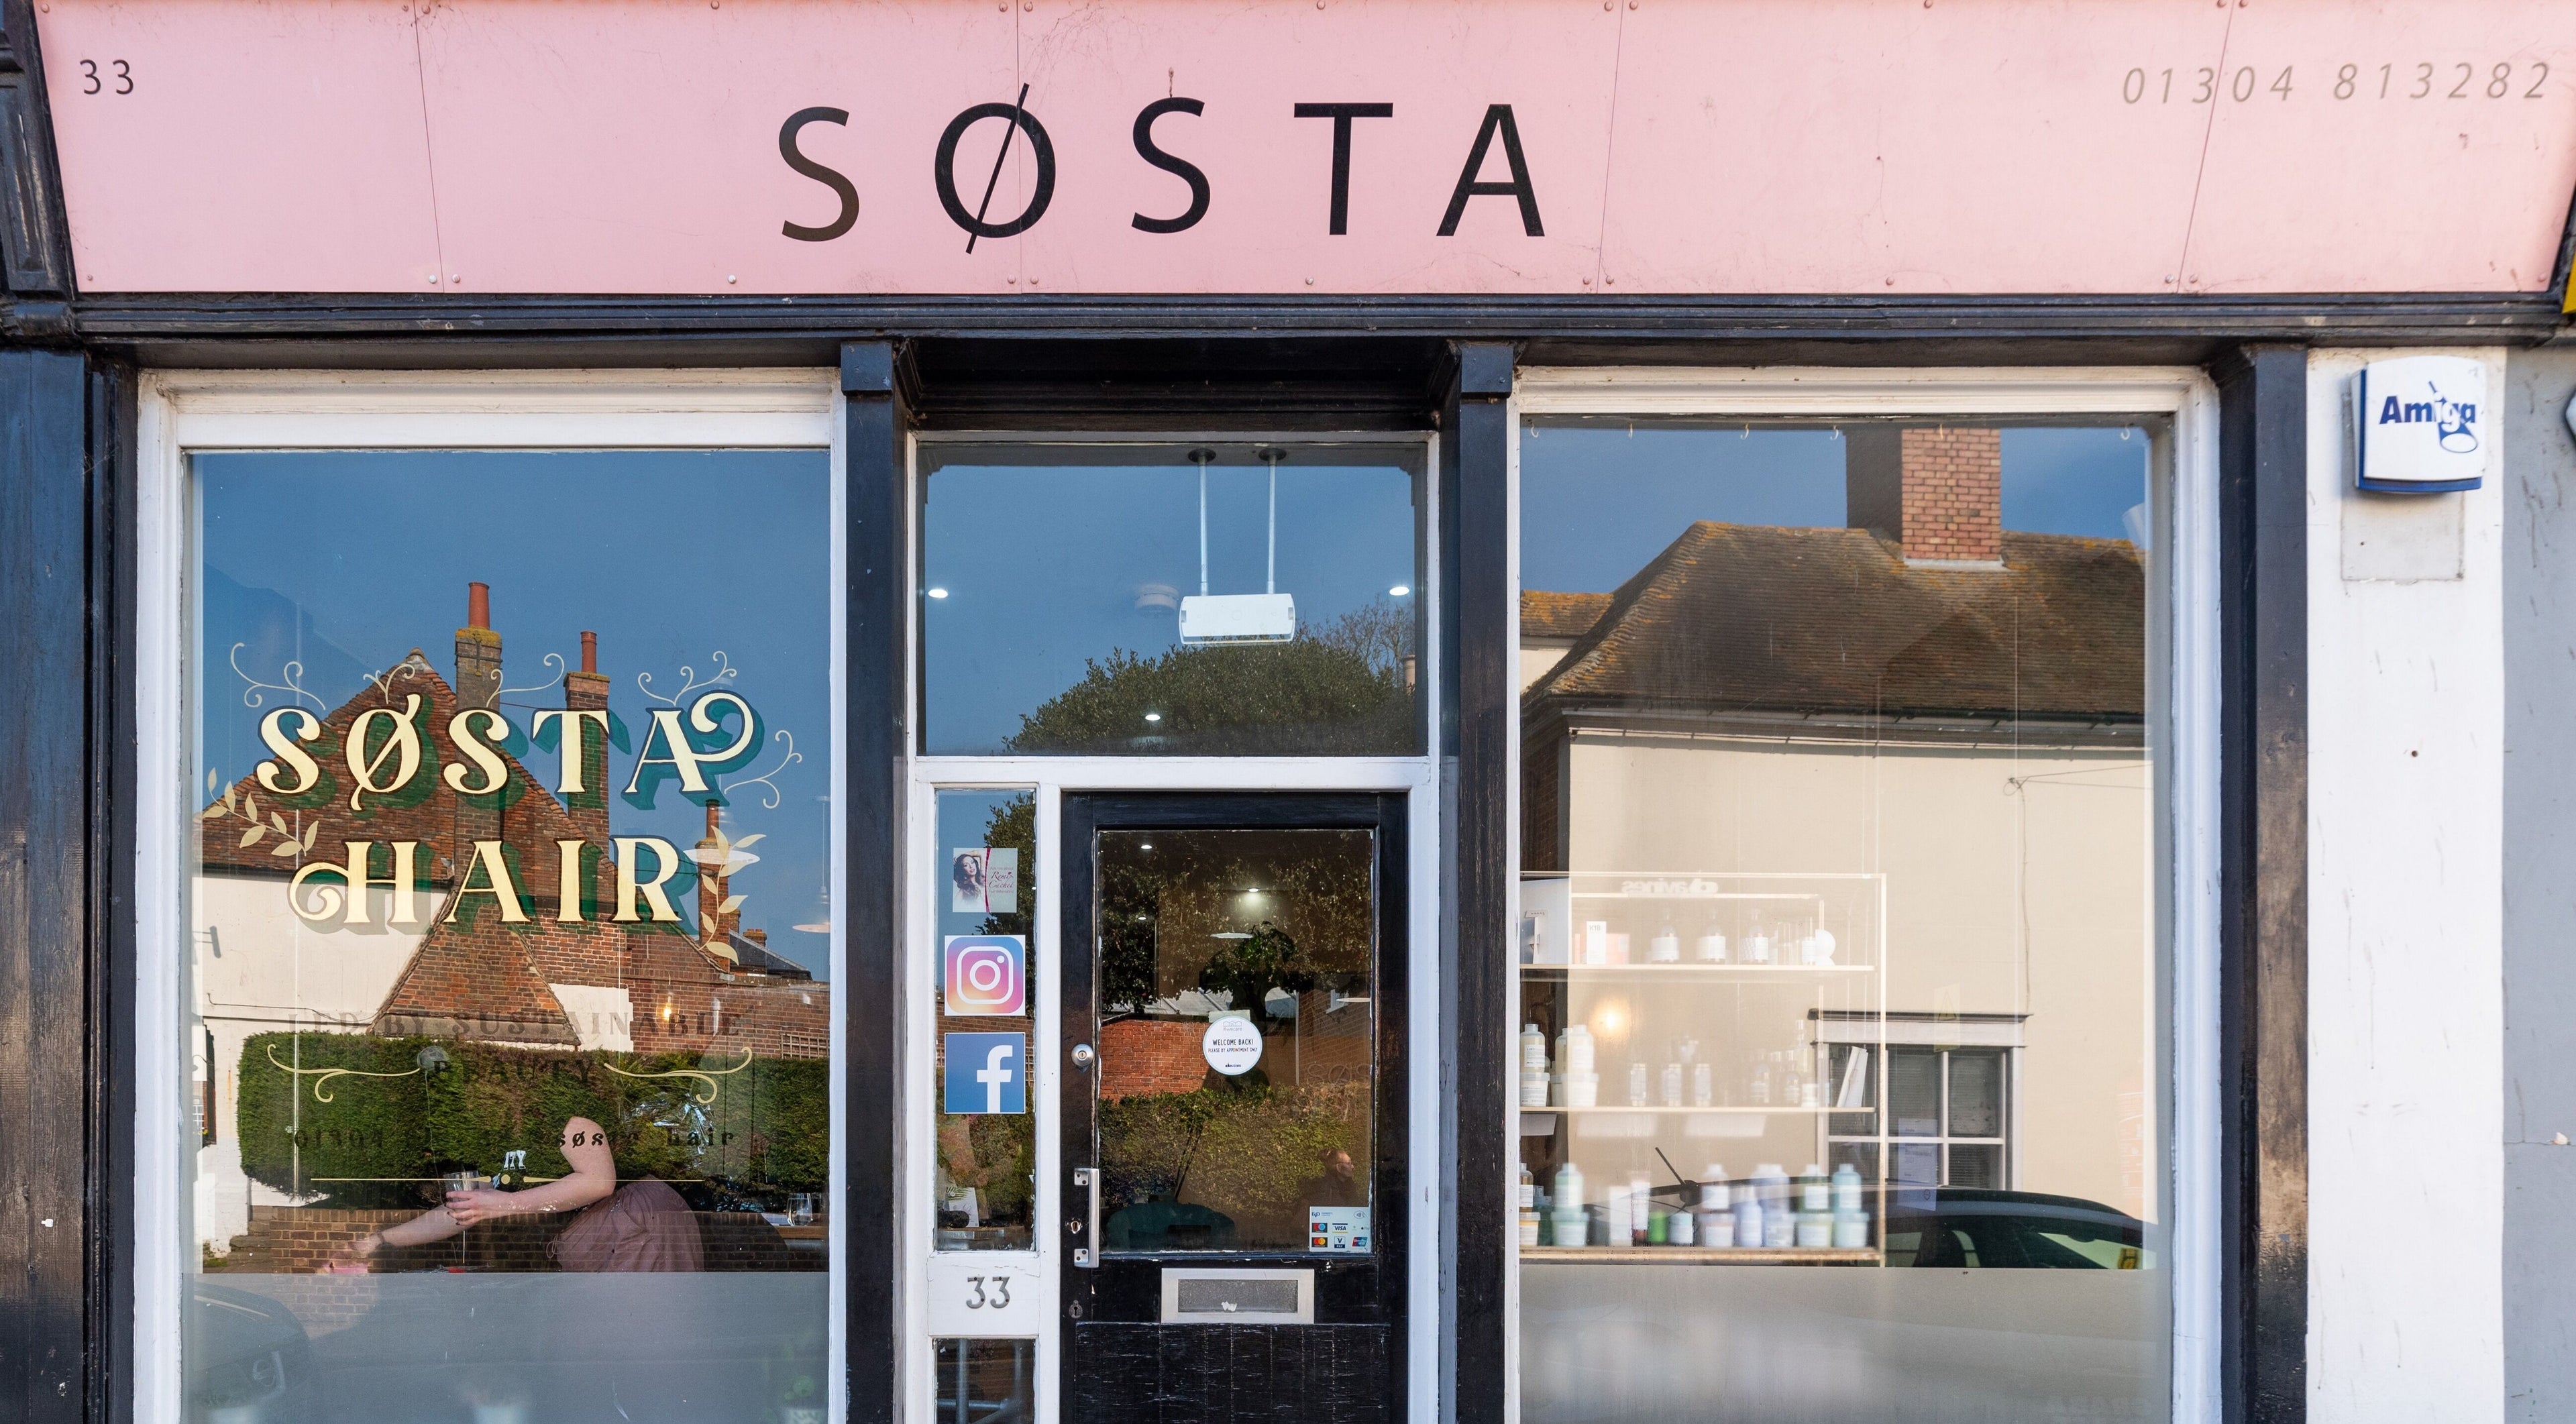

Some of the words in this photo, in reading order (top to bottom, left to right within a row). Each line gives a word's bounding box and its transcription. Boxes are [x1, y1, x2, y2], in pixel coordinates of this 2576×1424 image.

[79, 59, 133, 95] 33
[2123, 66, 2294, 104] 01304
[2333, 62, 2549, 101] 813282
[778, 83, 1546, 256] SØSTA
[2379, 394, 2476, 432] Amiga
[255, 691, 754, 812] SØSTA
[287, 837, 682, 924] HAIR
[383, 1011, 425, 1034] BY
[966, 1276, 1010, 1309] 33
